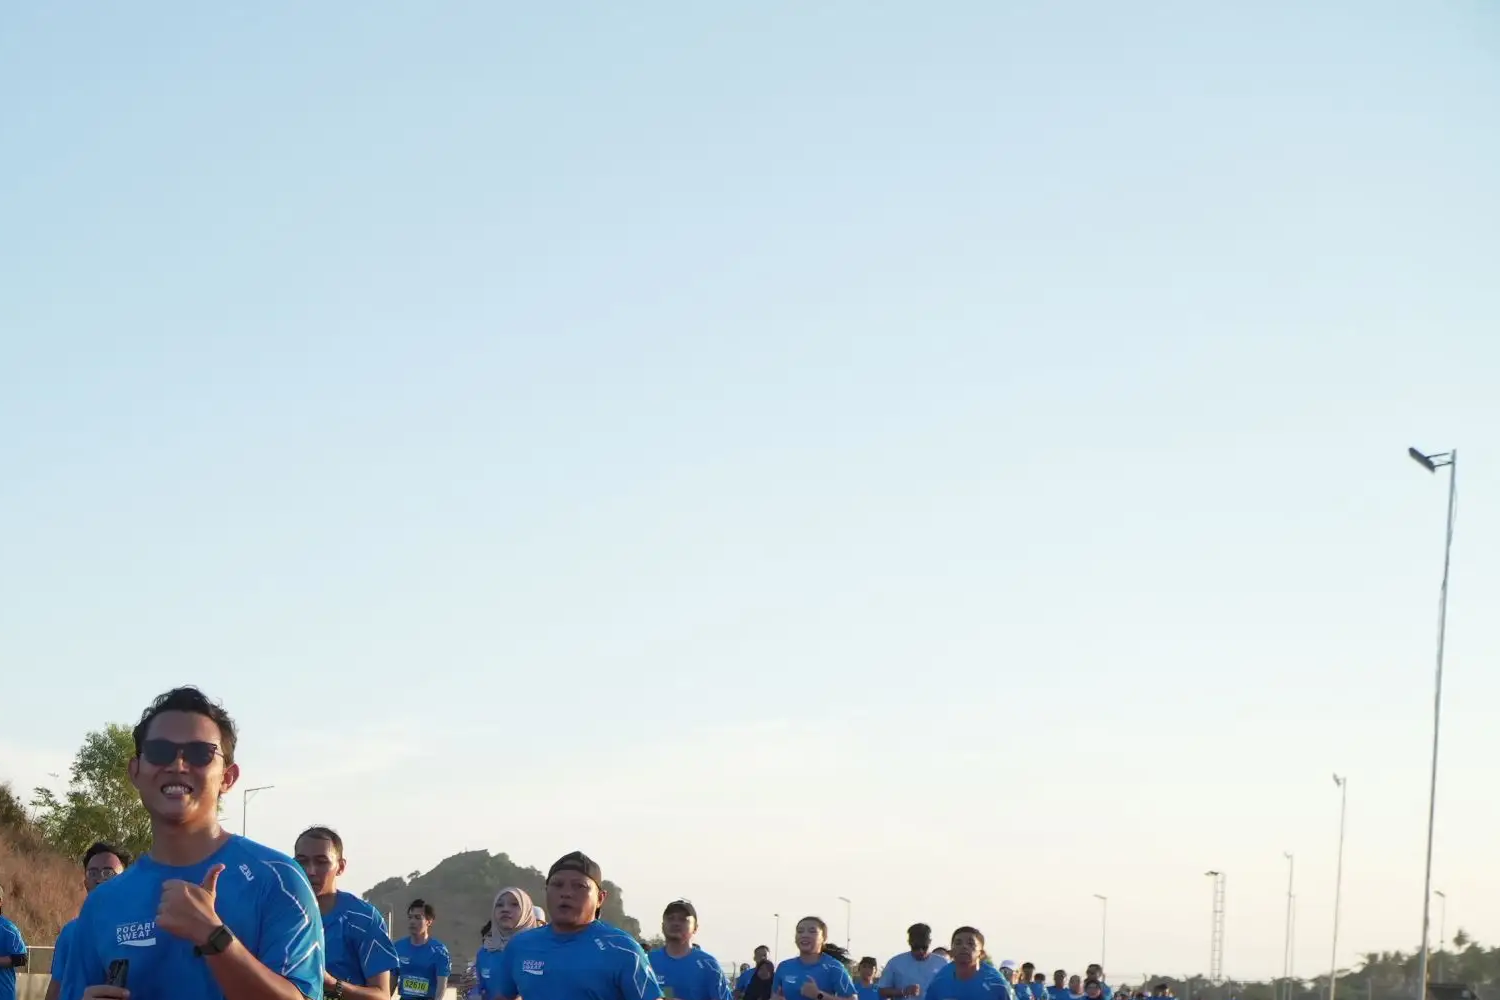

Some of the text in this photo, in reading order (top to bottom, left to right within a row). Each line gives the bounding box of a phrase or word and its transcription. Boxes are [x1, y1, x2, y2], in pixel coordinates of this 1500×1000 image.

[239, 863, 255, 882] 2XU
[116, 921, 155, 935] POCARI
[116, 930, 151, 942] SWEAT
